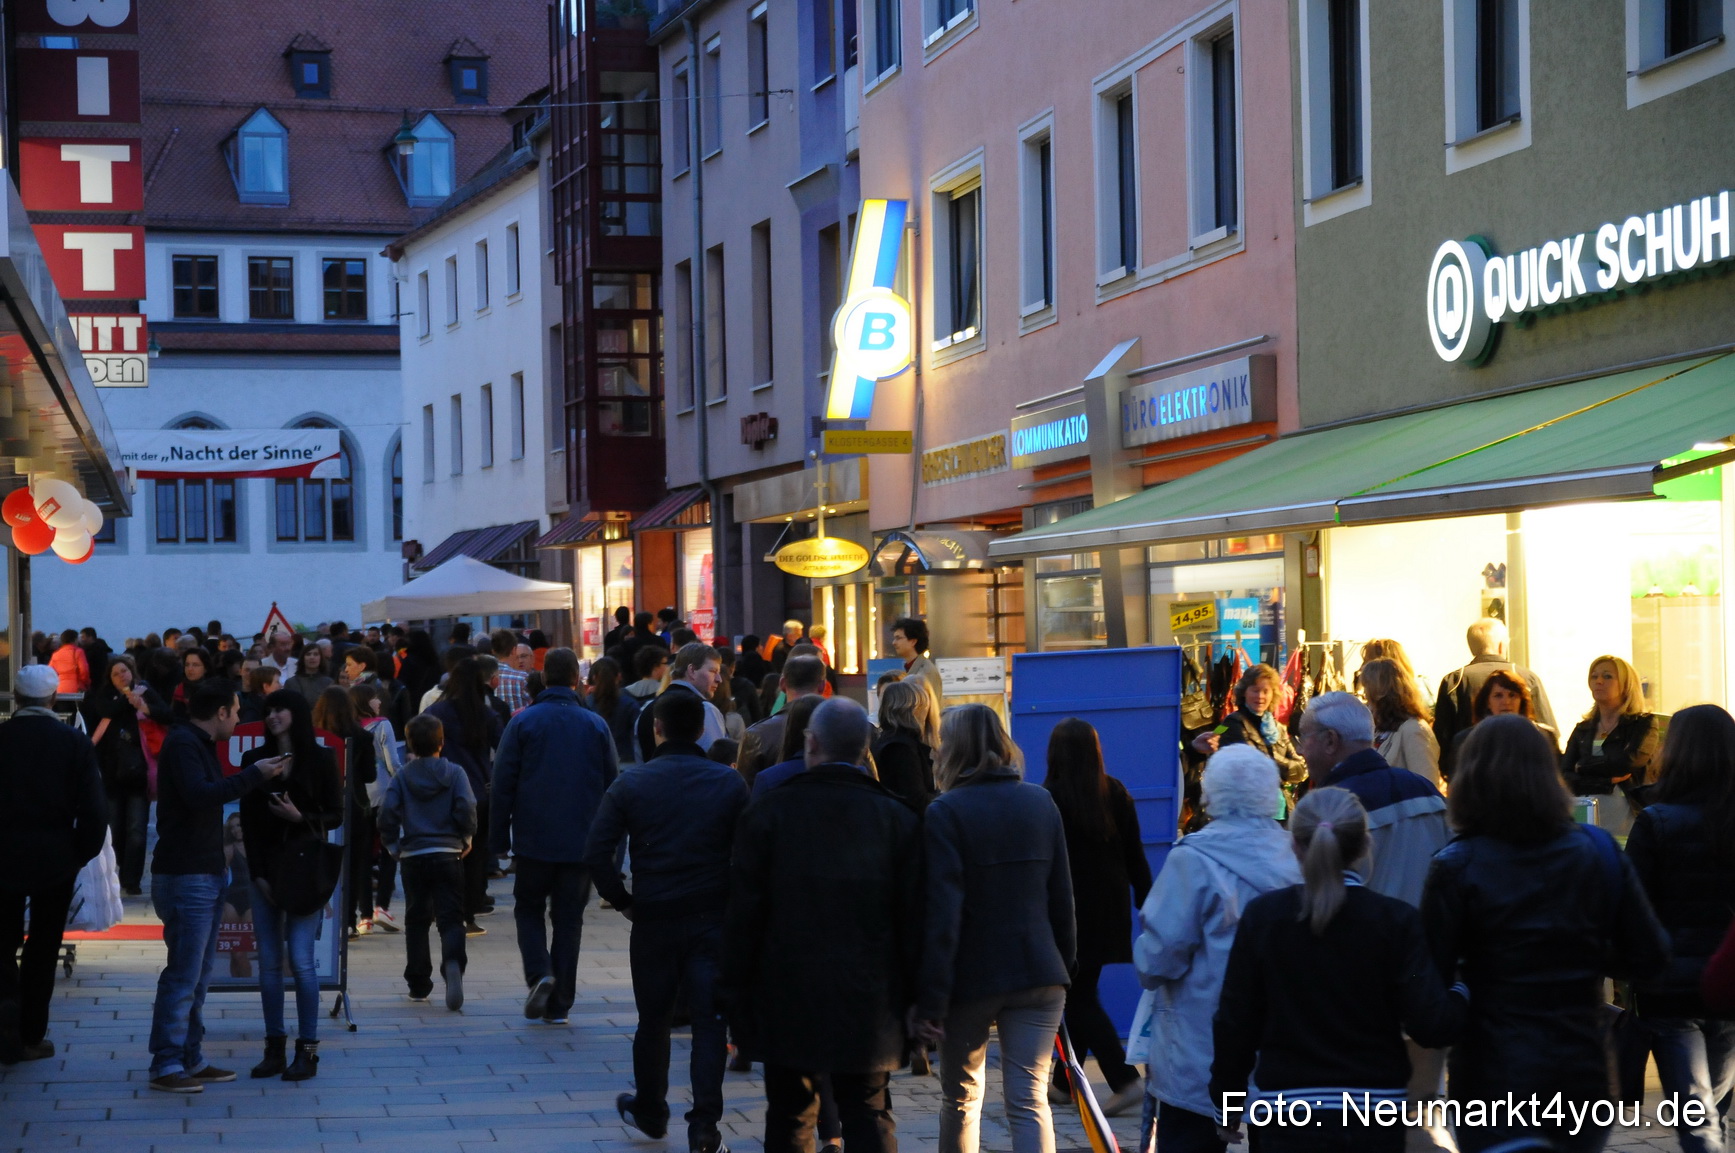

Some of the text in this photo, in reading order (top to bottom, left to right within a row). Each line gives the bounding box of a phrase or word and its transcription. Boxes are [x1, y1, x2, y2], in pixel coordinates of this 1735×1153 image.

[1483, 190, 1730, 323] QUICK SCHUH
[67, 316, 142, 351] ITT
[858, 312, 896, 351] B
[1123, 374, 1249, 433] BÜROELEKTRONIK
[829, 437, 909, 447] KLOSTERGASSE 4
[1012, 413, 1088, 457] KOMMUNIKATIO
[122, 452, 139, 461] mit
[141, 452, 157, 461] der
[228, 445, 258, 461] der
[796, 554, 865, 563] GOLDSCHMIEDE
[1175, 606, 1209, 626] 14,95
